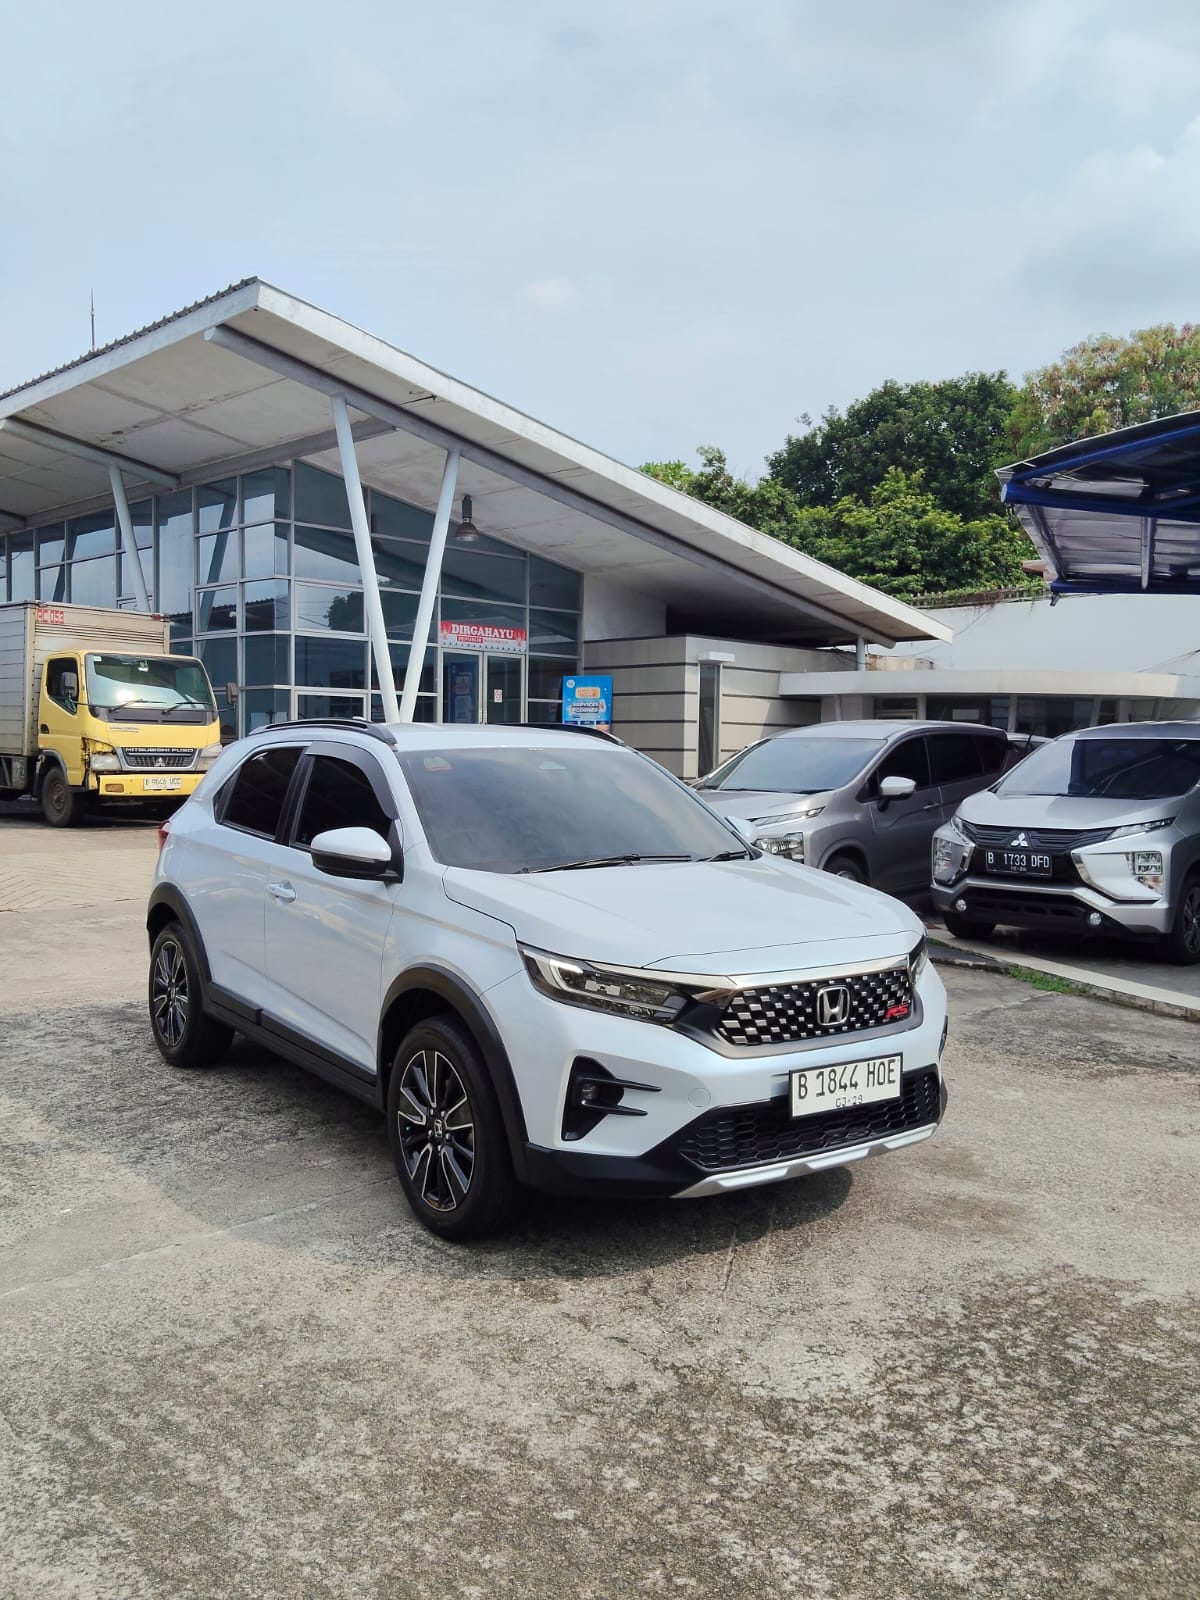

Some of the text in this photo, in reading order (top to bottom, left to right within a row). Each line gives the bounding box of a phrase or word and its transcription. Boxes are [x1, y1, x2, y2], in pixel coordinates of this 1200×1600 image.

[452, 623, 514, 639] DIRGAHAYU
[987, 852, 1050, 868] B 1733 DFD
[886, 1004, 909, 1018] RS
[798, 1059, 896, 1100] B 1844 HOE
